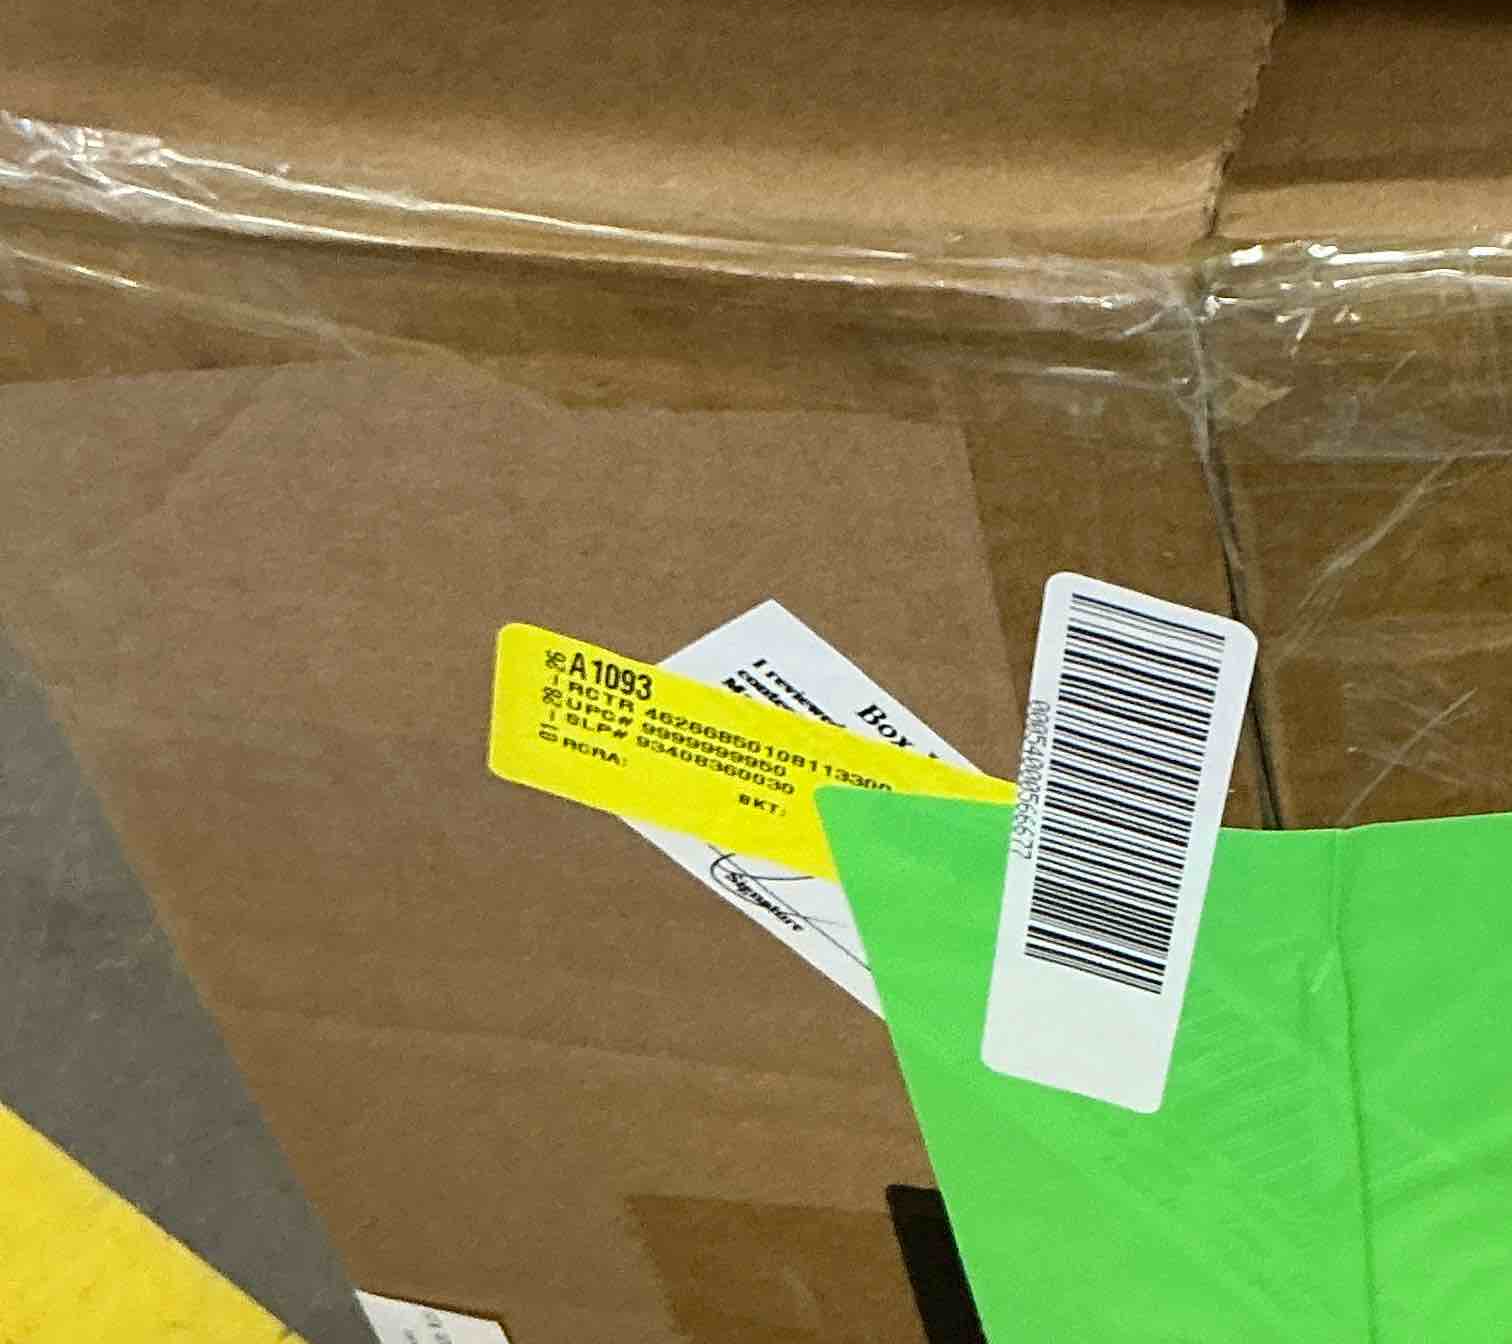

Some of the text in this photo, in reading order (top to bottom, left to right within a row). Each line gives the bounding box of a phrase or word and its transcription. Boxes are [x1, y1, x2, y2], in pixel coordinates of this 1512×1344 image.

[566, 698, 635, 728] UPC#
[856, 702, 917, 753] Box
[725, 870, 806, 934] Signature
